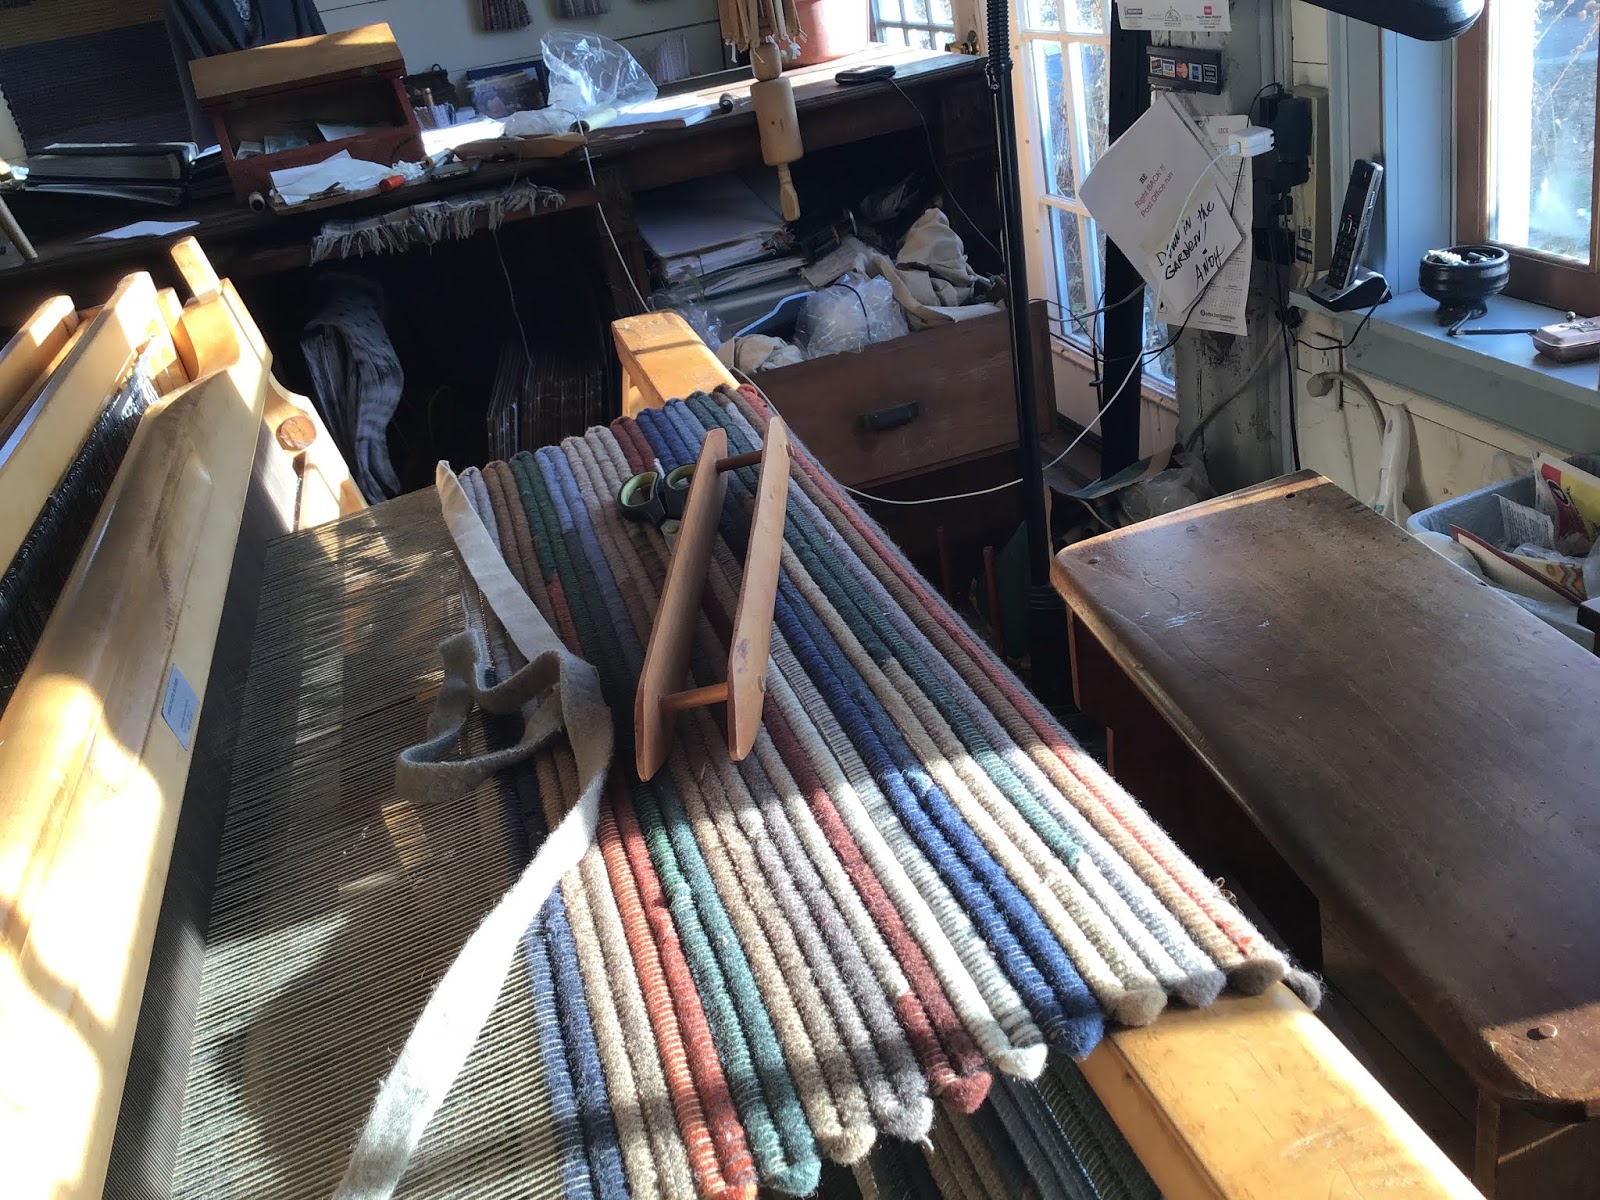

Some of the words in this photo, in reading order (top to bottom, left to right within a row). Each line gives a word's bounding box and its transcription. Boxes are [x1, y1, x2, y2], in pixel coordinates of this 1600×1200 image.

[1134, 190, 1149, 208] Right
[1146, 170, 1162, 191] BACK
[1139, 173, 1148, 184] BE
[1140, 201, 1154, 218] Post
[1151, 183, 1166, 202] Office
[1164, 172, 1174, 184] run
